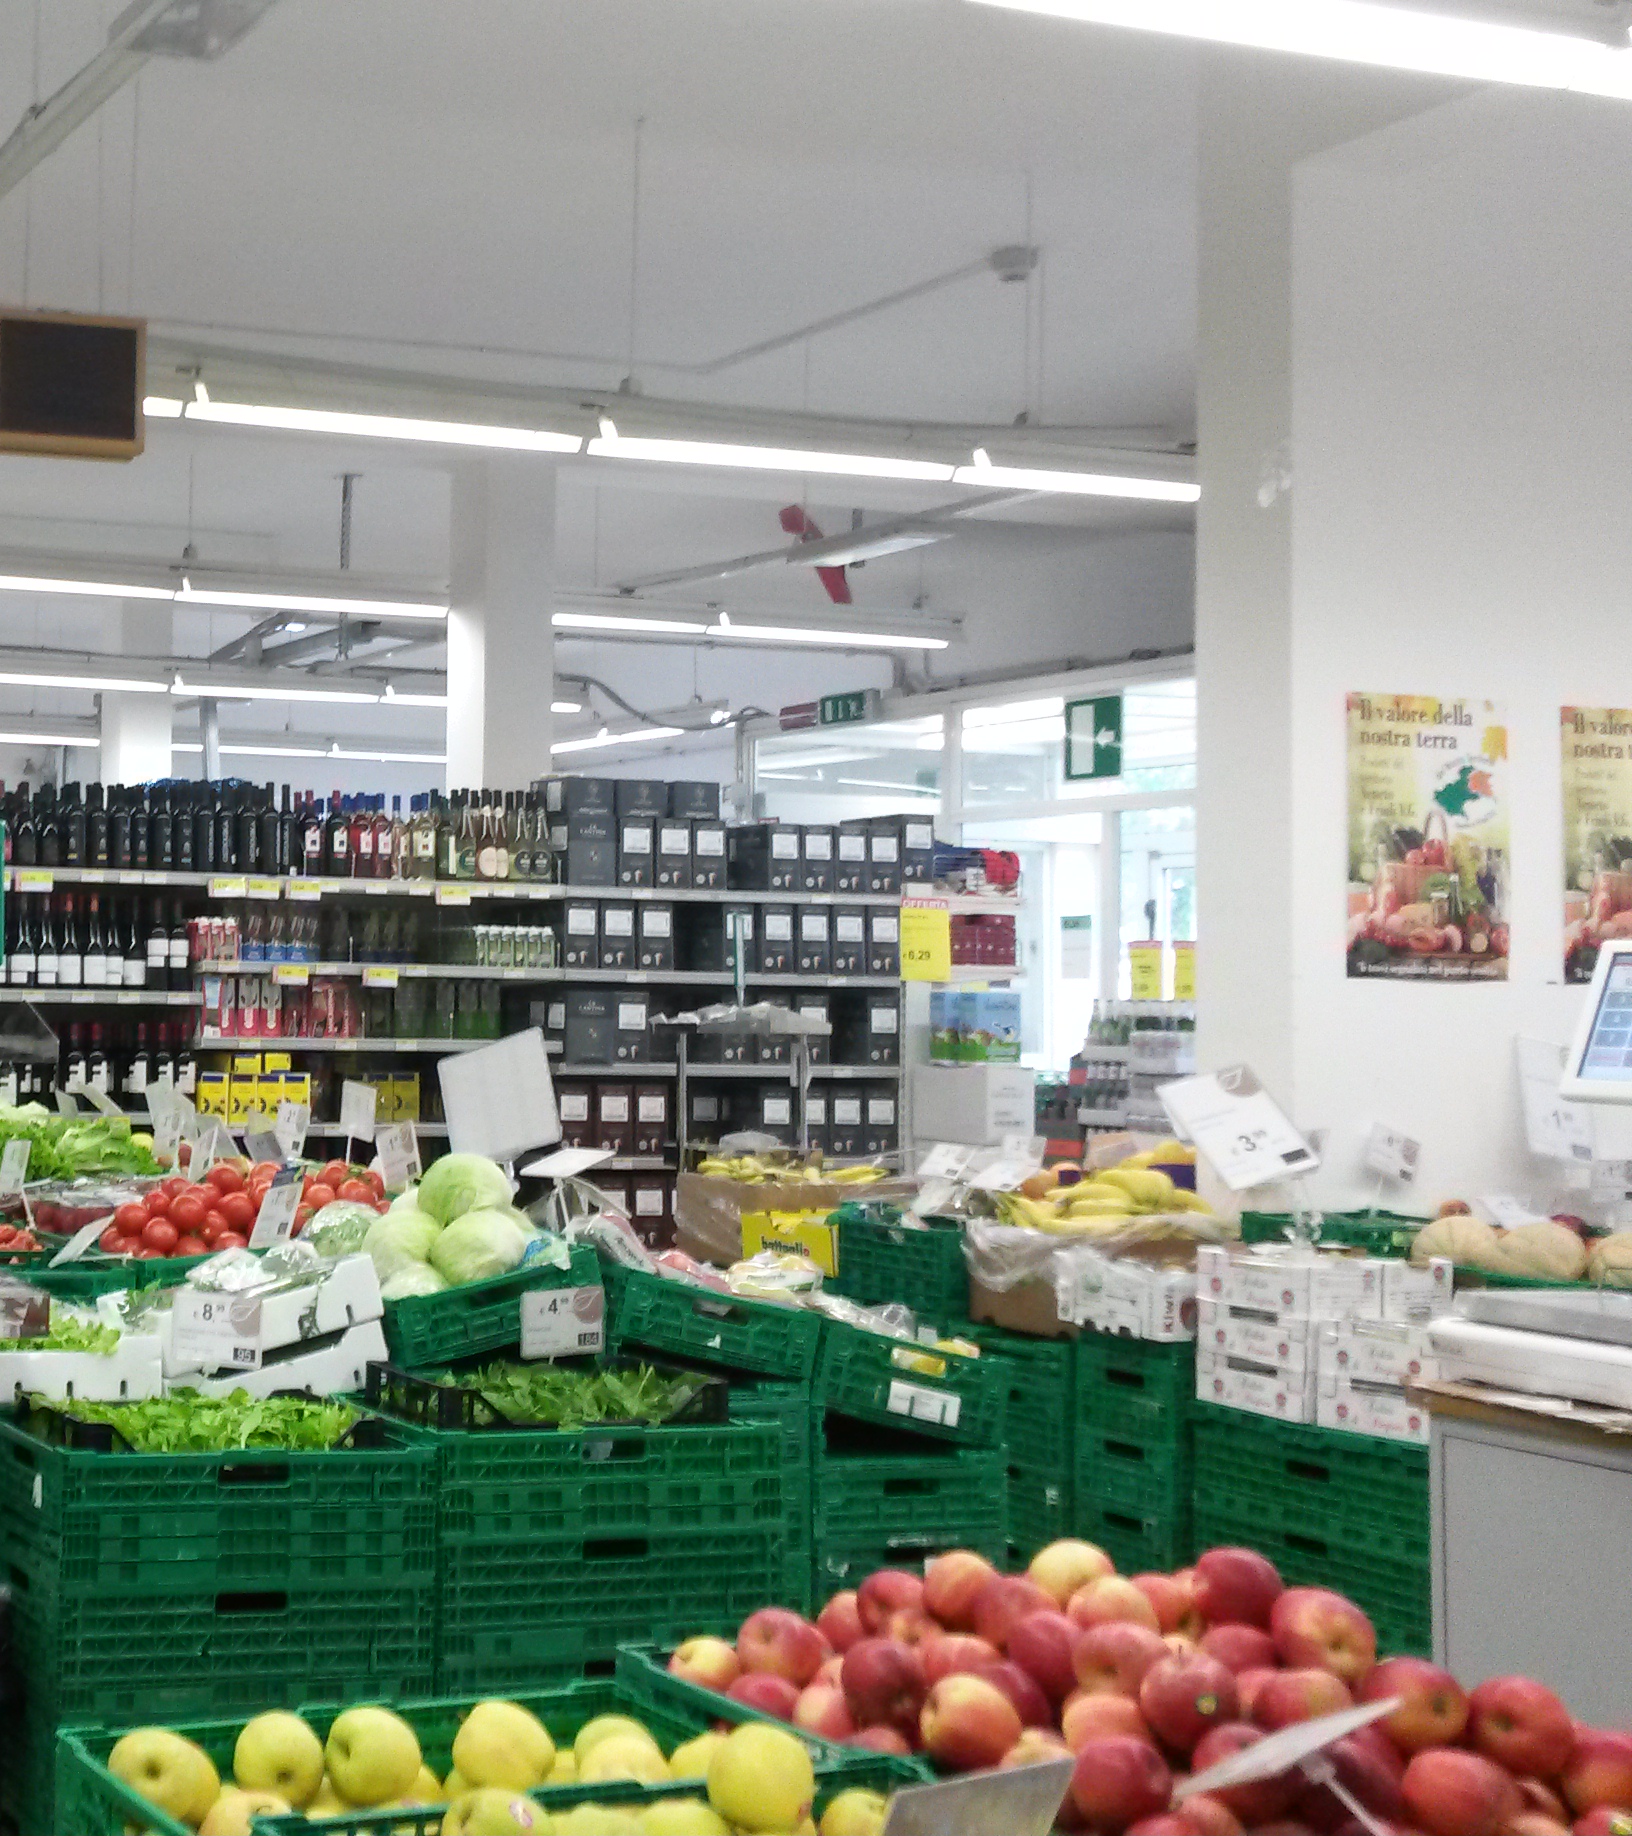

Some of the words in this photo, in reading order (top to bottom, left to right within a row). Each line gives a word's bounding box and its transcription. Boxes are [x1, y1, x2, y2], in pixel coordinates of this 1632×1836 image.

[1360, 698, 1372, 721] Il
[1376, 700, 1428, 723] valore
[1433, 703, 1473, 726] della
[1589, 714, 1632, 735] valor
[1360, 730, 1411, 747] nostra
[1416, 732, 1458, 750] terra
